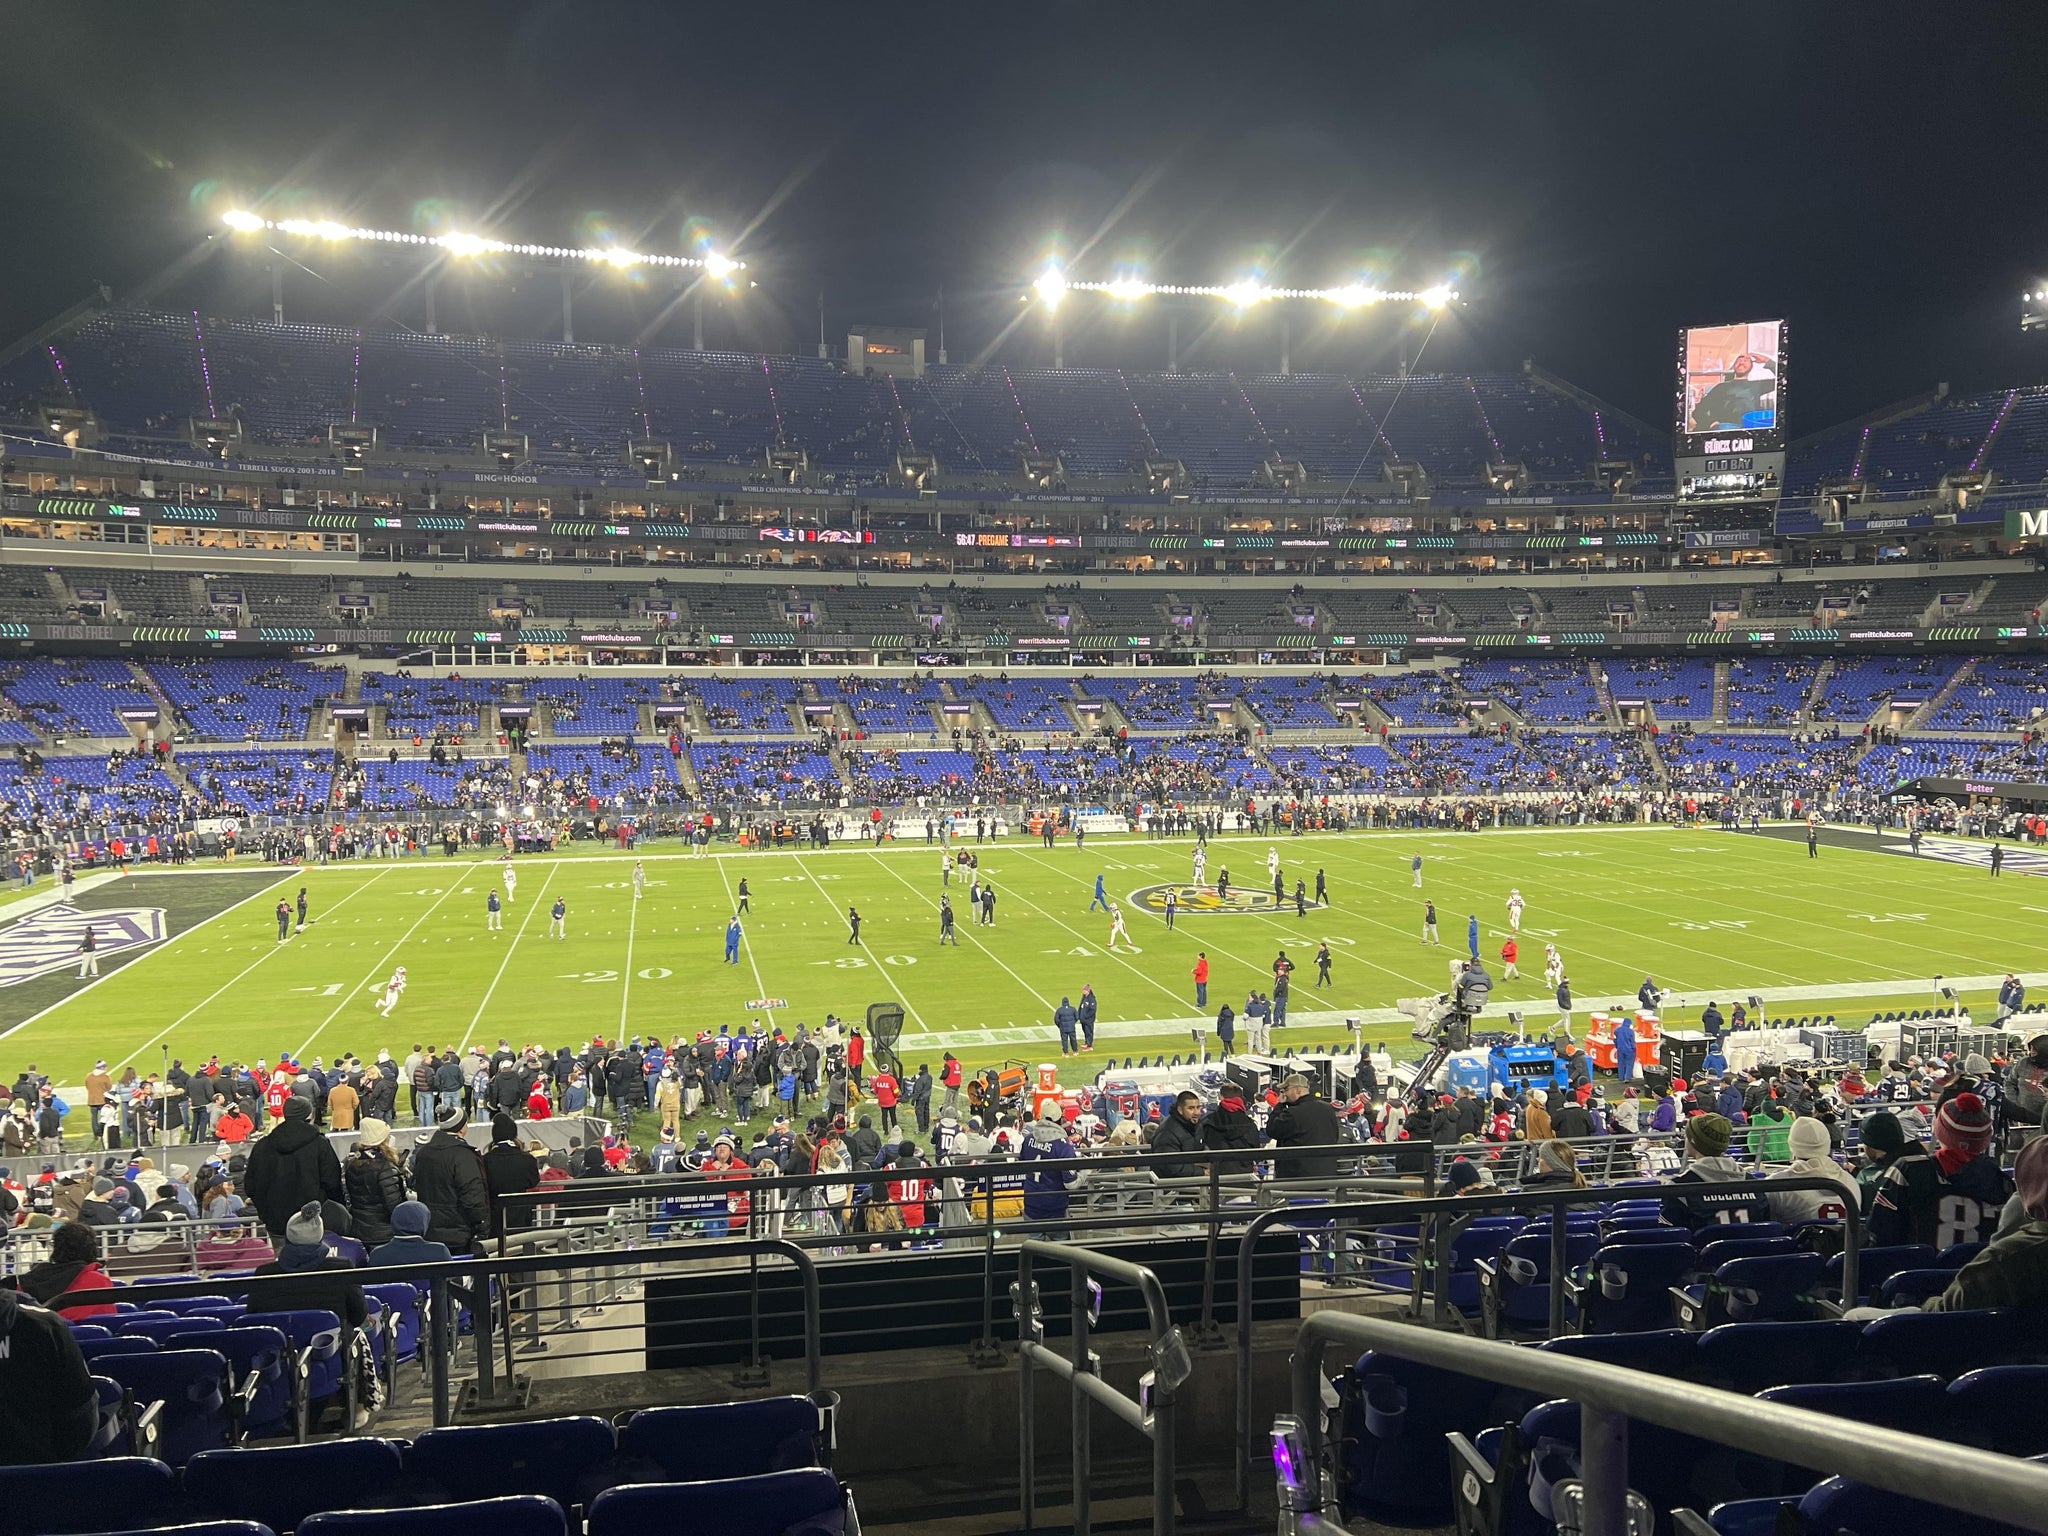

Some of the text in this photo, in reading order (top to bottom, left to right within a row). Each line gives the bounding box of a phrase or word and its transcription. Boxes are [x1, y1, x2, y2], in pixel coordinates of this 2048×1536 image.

[1731, 438, 1754, 452] CAM
[238, 463, 337, 476] TERRELL SUGGS 2003-2018
[1707, 457, 1751, 472] OLD BAY
[474, 473, 498, 483] RING
[503, 474, 538, 484] HONOR
[741, 485, 765, 493] WORLD
[765, 486, 802, 495] CHAMPIONS
[1650, 493, 1675, 501] HONOR
[236, 511, 294, 525] TRY US FREE!
[1866, 518, 1908, 529] #RAVENSFLOCK
[2019, 509, 2048, 537] M
[478, 522, 538, 532] merrittclubs.com
[701, 527, 748, 539] TRY US FREE!
[956, 533, 1009, 546] 56:47 PREGAME
[1094, 536, 1136, 547] TRY US FREE!
[1468, 537, 1483, 548] TRY
[1484, 537, 1494, 548] US
[1714, 531, 1750, 542] merritt
[1281, 539, 1330, 547] merrittclubs.com
[46, 625, 113, 639] TRY US FREE!
[333, 629, 392, 642] TRY US FREE!
[580, 633, 641, 643] merrittclubs.com
[1849, 631, 1914, 639] merrittclubs.com
[806, 634, 854, 646] TRY US FREE!
[1018, 637, 1070, 645] merrittclubs.com
[1218, 635, 1262, 646] TRY US FREE!
[1415, 636, 1466, 644] merrittclubs.com
[1622, 633, 1670, 644] TRY US FREE!
[1965, 783, 1995, 793] Better
[1275, 936, 1356, 948] 50
[834, 955, 918, 969] 30
[581, 967, 673, 983] 20
[1589, 1047, 1597, 1060] G
[1043, 1073, 1051, 1082] G
[1893, 1084, 1909, 1099] 29
[270, 1094, 282, 1106] 10
[941, 1134, 953, 1150] 10
[1028, 1137, 1052, 1153] FLOWERS
[900, 1179, 919, 1201] 10
[1467, 1478, 1477, 1498] 30
